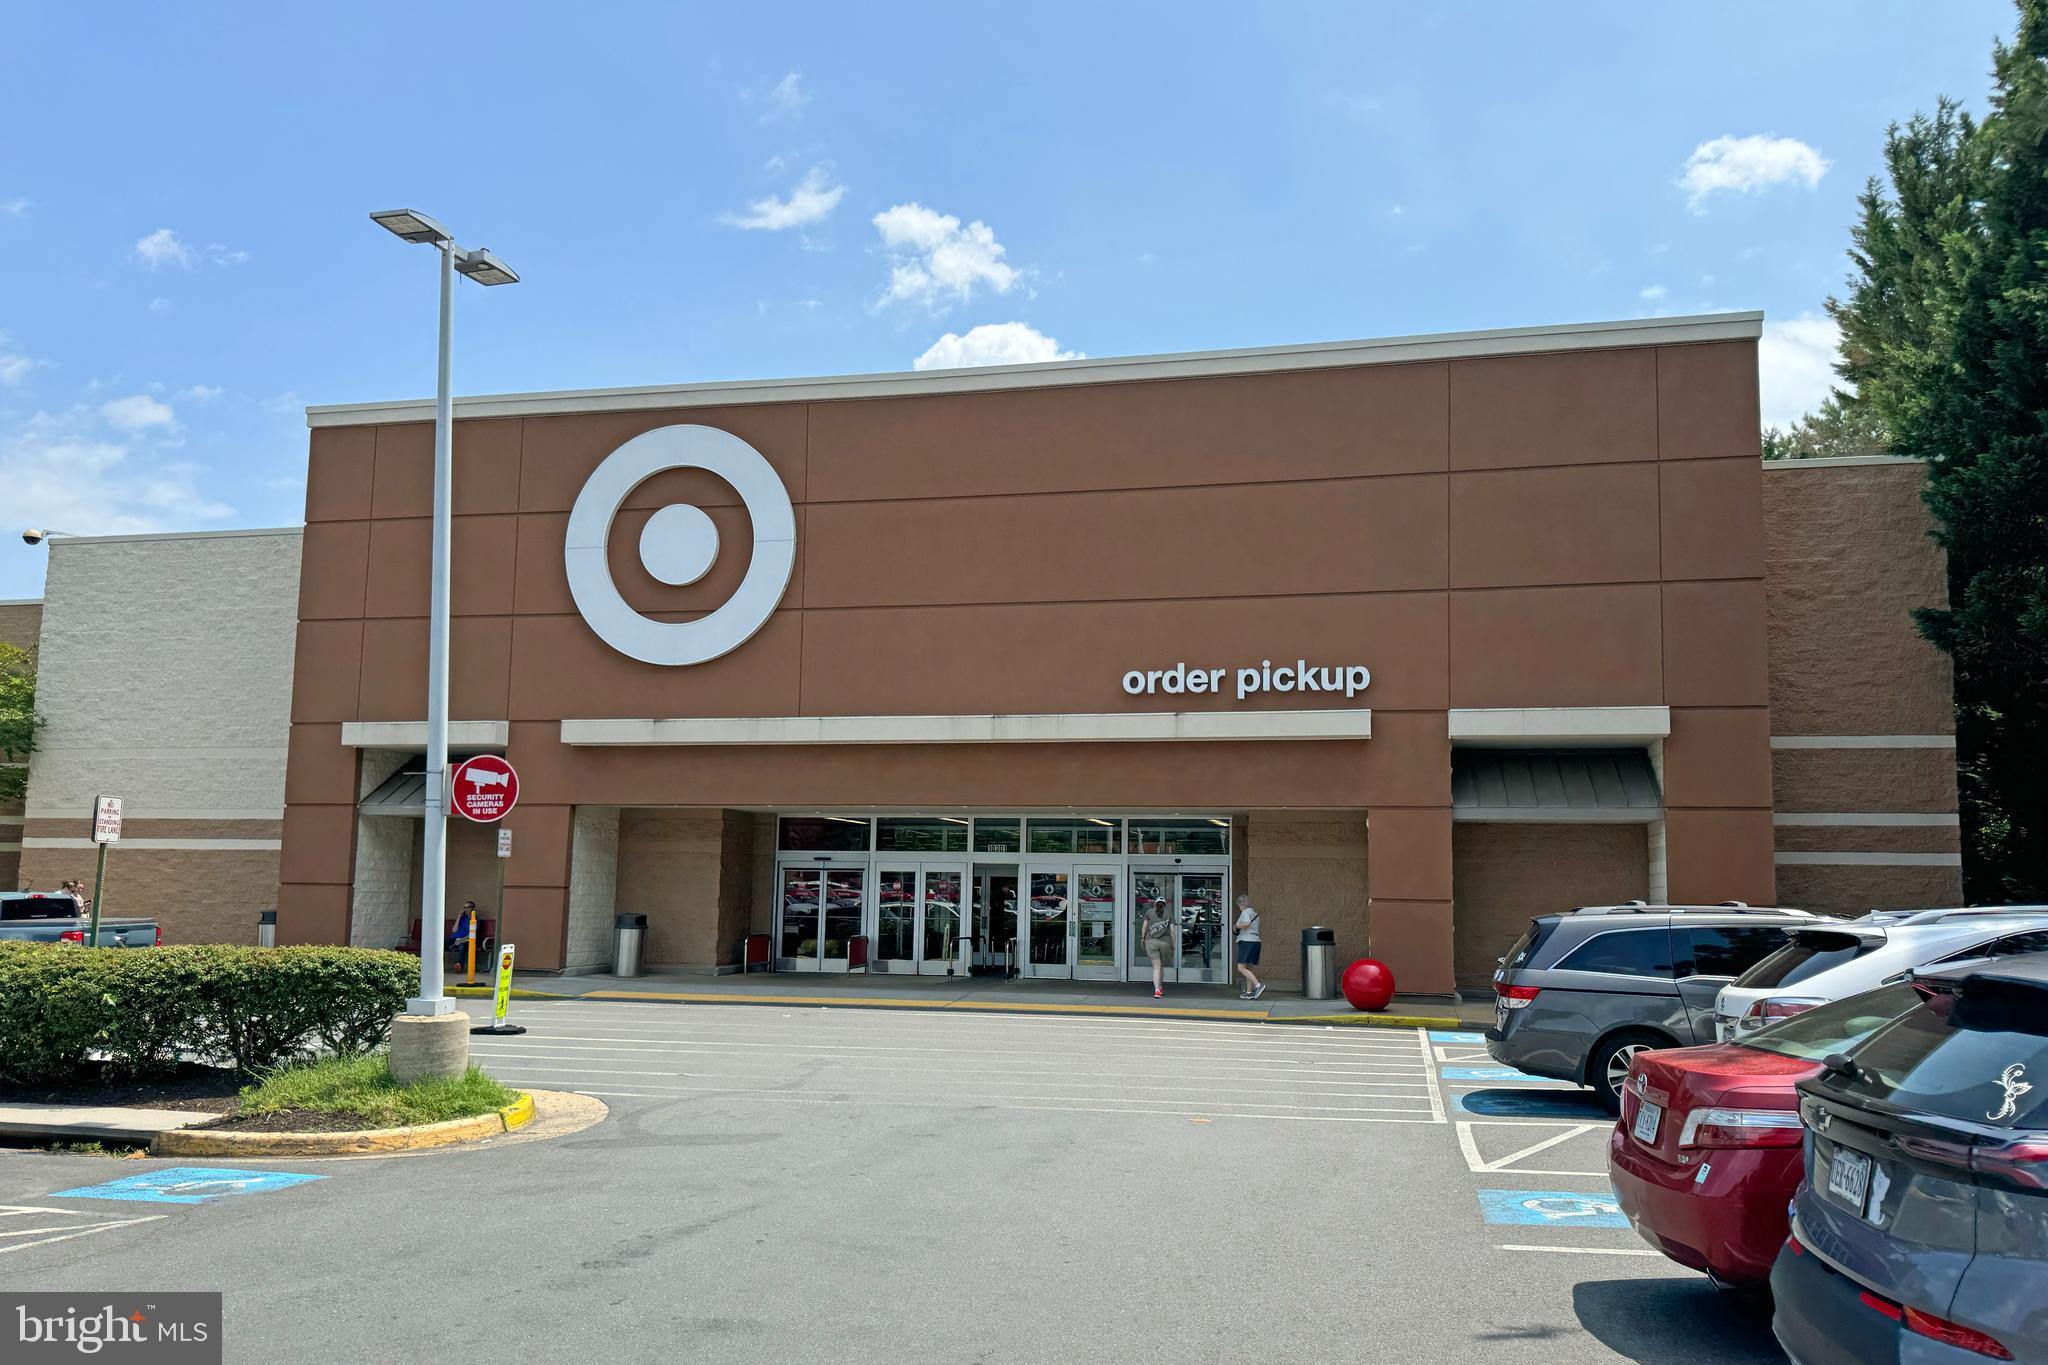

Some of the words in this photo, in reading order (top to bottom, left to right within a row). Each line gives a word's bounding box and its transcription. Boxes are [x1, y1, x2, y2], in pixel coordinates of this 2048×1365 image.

[1122, 662, 1226, 695] order
[1237, 659, 1371, 699] pickup
[100, 807, 120, 815] PARKING
